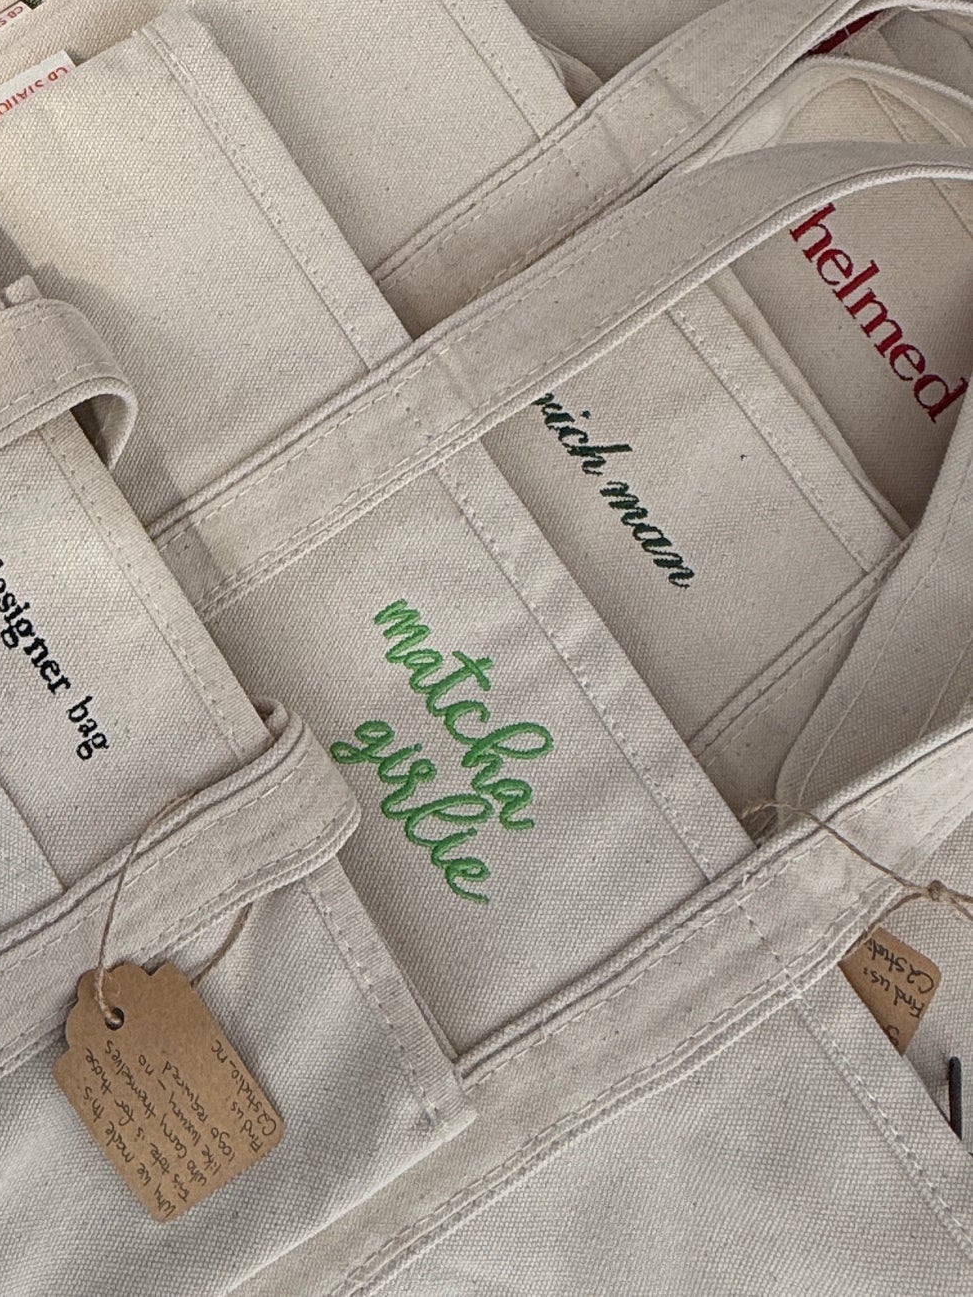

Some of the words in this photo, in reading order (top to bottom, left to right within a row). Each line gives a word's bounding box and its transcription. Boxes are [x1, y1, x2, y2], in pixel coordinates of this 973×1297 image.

[6, 6, 23, 19] CB
[599, 479, 695, 589] man
[66, 695, 110, 761] bag
[373, 598, 555, 832] matcha
[329, 720, 494, 905] girlie
[863, 966, 891, 992] us:
[893, 985, 925, 1019] Find
[85, 1047, 112, 1095] those
[105, 1040, 156, 1120] themselves
[138, 1054, 155, 1077] no
[161, 1060, 208, 1123] required
[114, 1098, 134, 1127] for
[169, 1091, 202, 1147] luxury
[104, 1120, 135, 1164] made
[134, 1126, 146, 1142] is
[160, 1113, 187, 1159] carry
[210, 1127, 236, 1162] logo
[239, 1119, 263, 1152] Find
[136, 1162, 152, 1187] we
[150, 1142, 170, 1175] tote
[187, 1160, 207, 1186] who
[201, 1144, 222, 1176] like
[153, 1183, 177, 1219] Why
[172, 1173, 190, 1202] This
